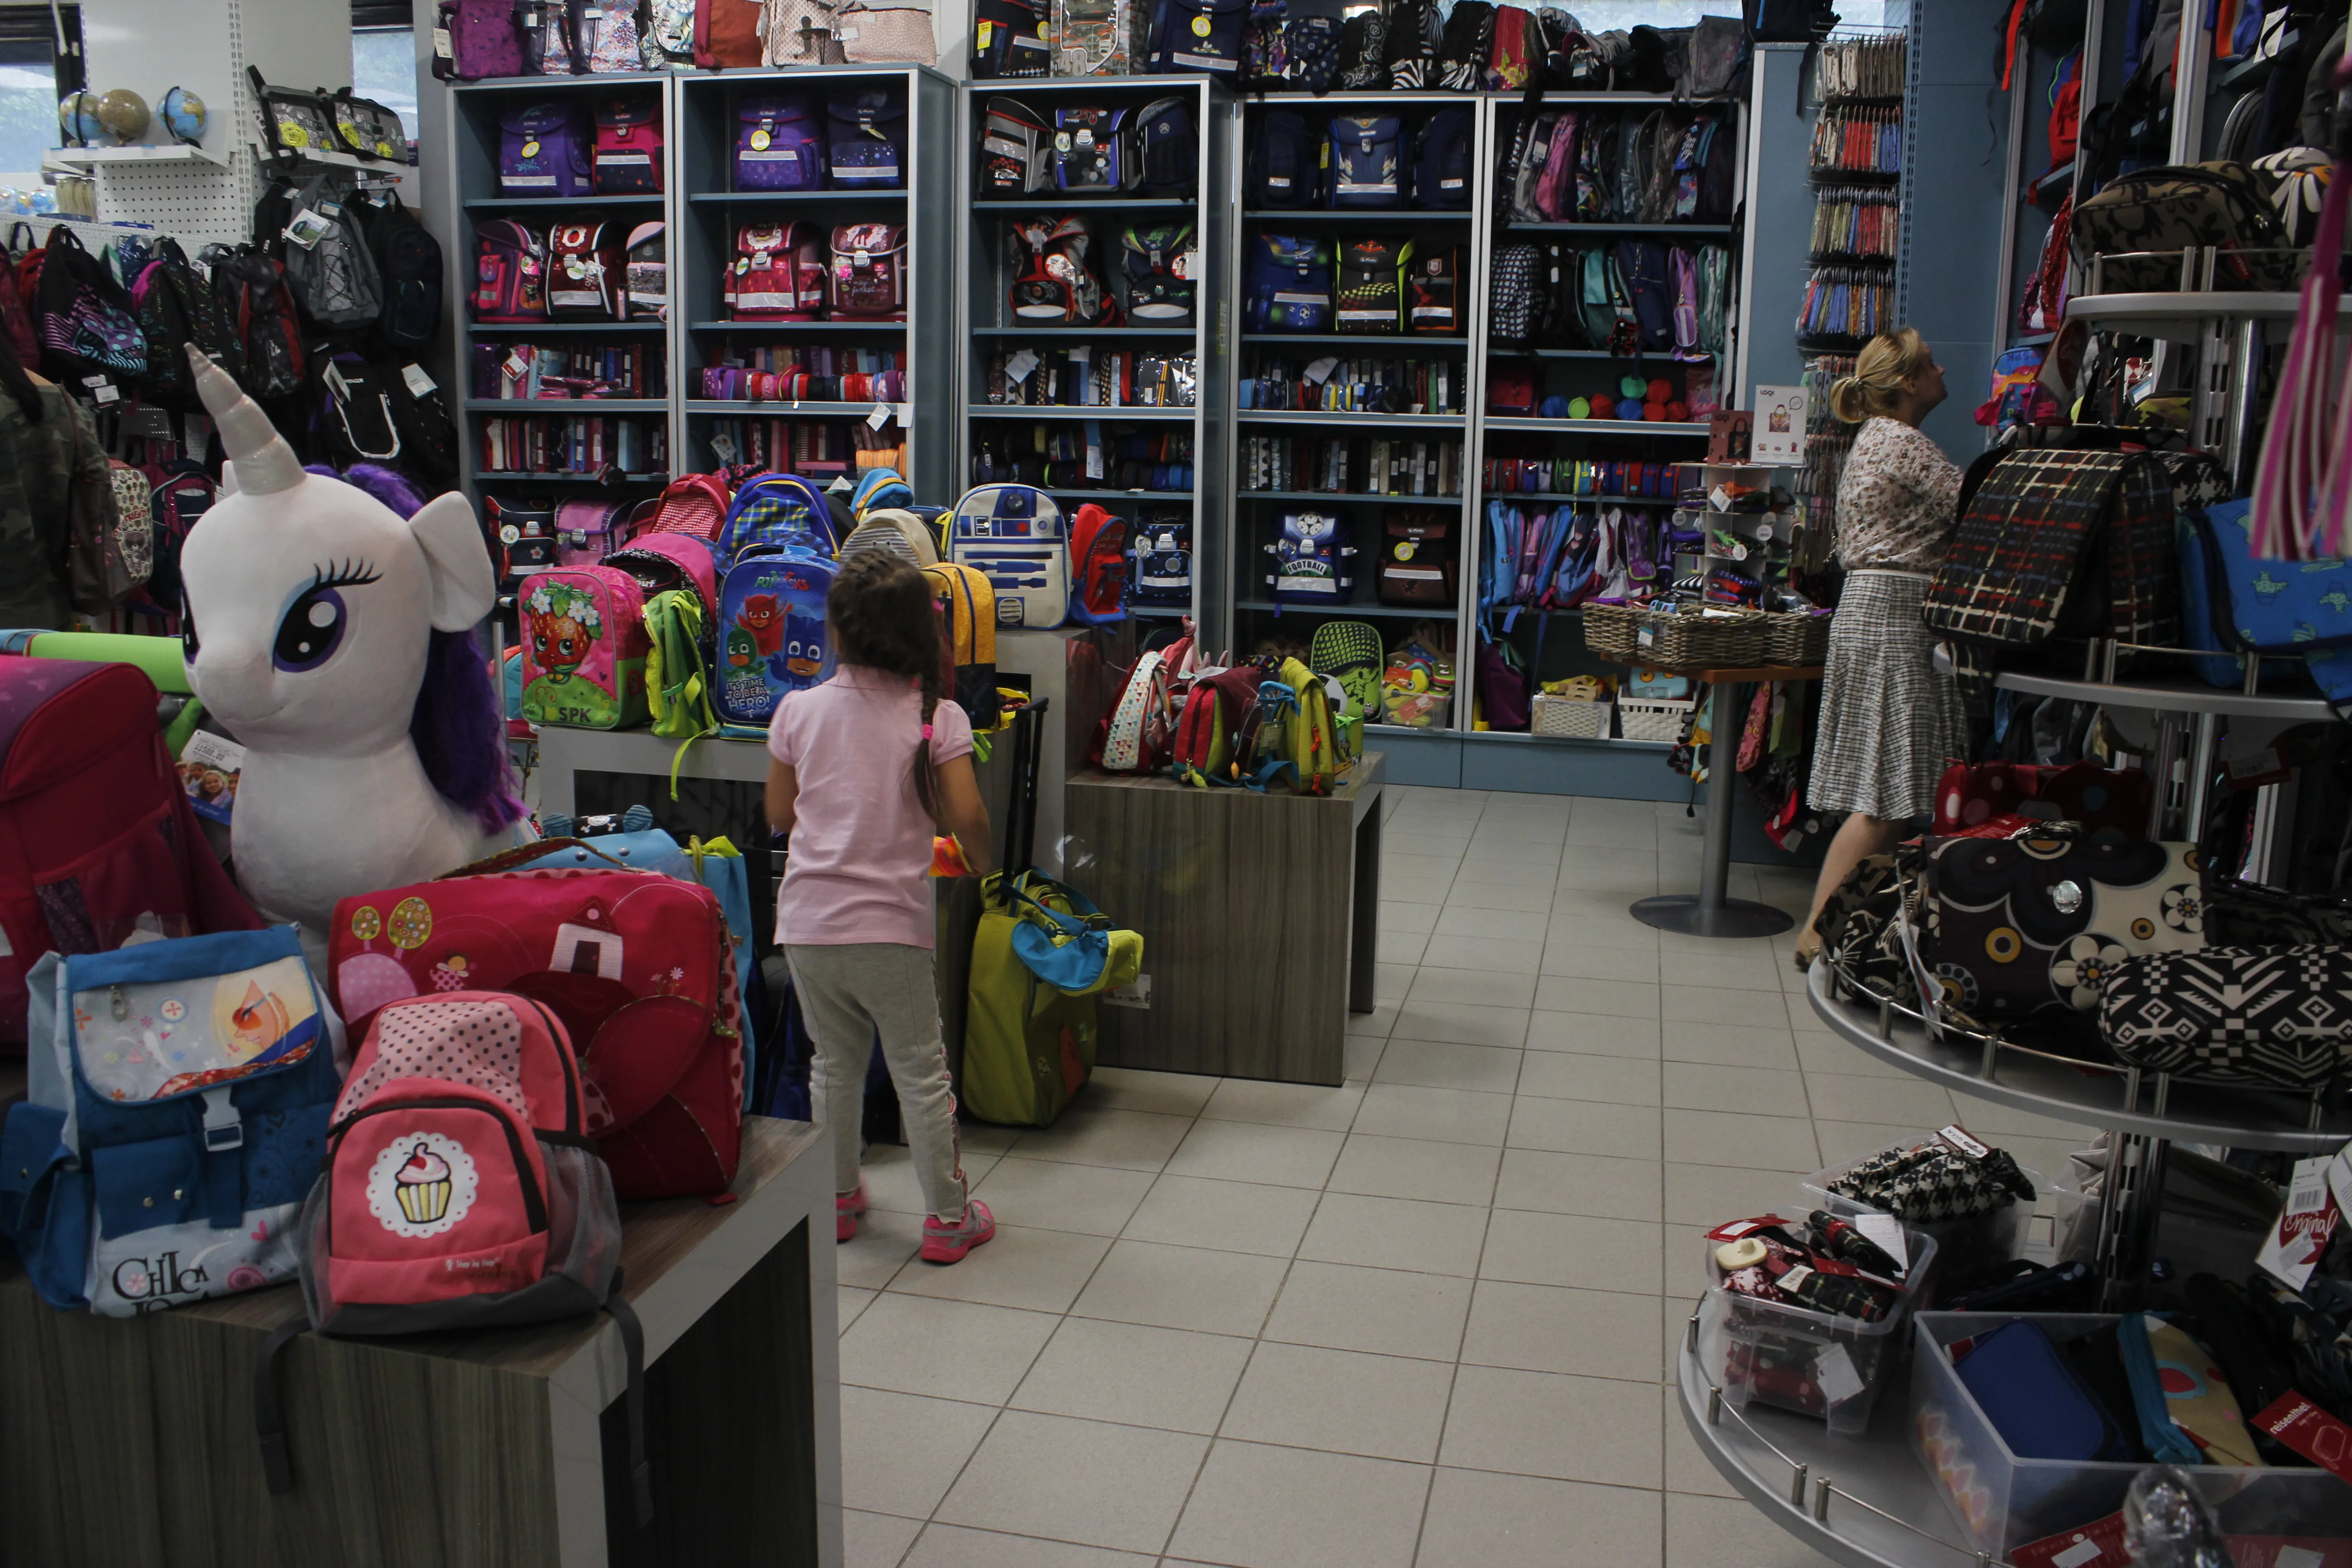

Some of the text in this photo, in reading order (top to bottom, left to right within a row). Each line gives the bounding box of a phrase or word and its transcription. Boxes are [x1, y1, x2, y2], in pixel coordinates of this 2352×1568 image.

[1060, 49, 1087, 77] 48
[1715, 414, 1730, 424] LOQI
[1288, 560, 1324, 573] FOOTBALL
[742, 678, 765, 687] TIME
[727, 686, 766, 699] TO BE A
[728, 695, 770, 712] HERO!
[559, 706, 592, 723] SPK
[2284, 1208, 2339, 1243] Original
[113, 1250, 210, 1300] CHICA
